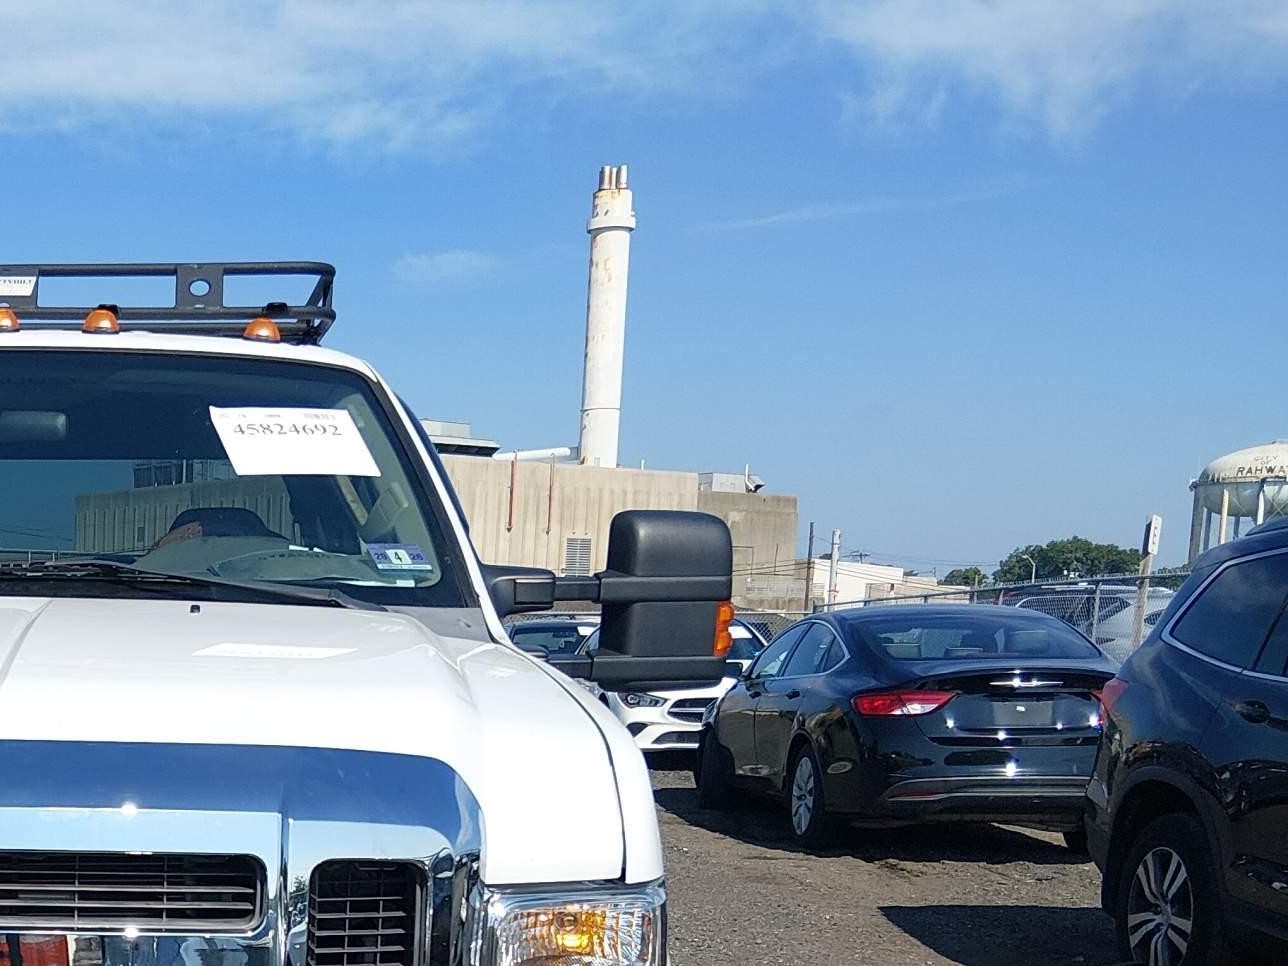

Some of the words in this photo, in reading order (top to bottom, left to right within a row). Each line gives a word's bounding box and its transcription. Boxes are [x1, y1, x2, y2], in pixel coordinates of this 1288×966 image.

[233, 423, 343, 437] 45824692
[1236, 465, 1288, 476] RAHWA
[394, 551, 403, 563] 4
